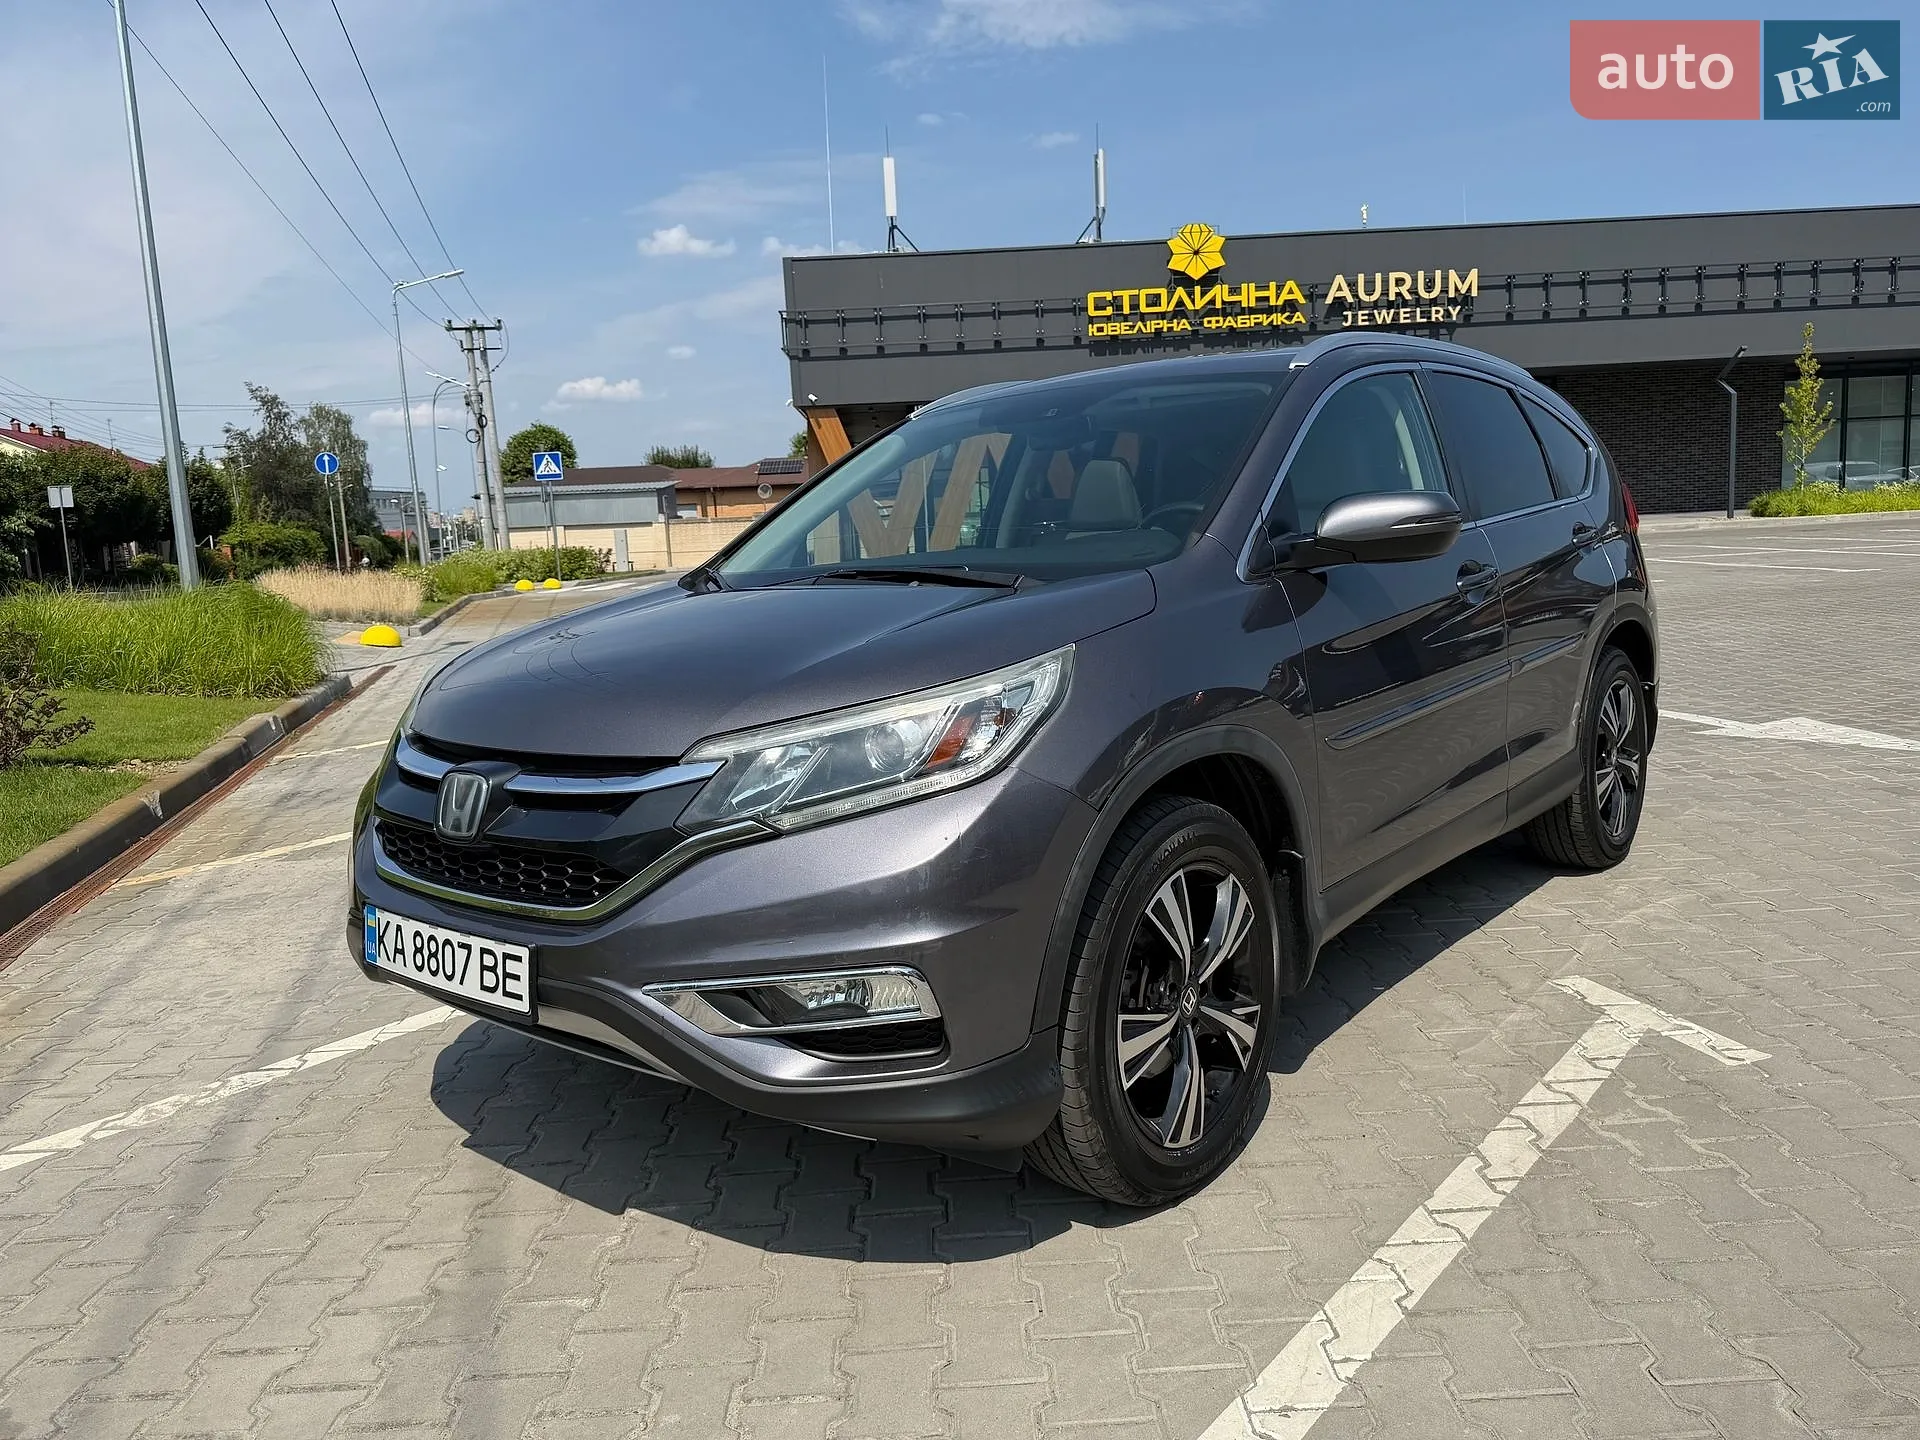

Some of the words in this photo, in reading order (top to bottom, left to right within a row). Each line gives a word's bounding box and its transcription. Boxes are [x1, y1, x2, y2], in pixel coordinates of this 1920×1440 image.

[1087, 280, 1306, 317] СТОЛИЧНА
[1325, 268, 1479, 304] AURUM
[1088, 318, 1192, 337] ЮВЕЛІРНА
[1203, 311, 1306, 330] ФАБРИКА
[1342, 305, 1462, 327] JEWELRY
[367, 940, 376, 955] UA
[377, 917, 407, 968] KA
[412, 930, 472, 986] 8807
[479, 946, 524, 1002] BE
